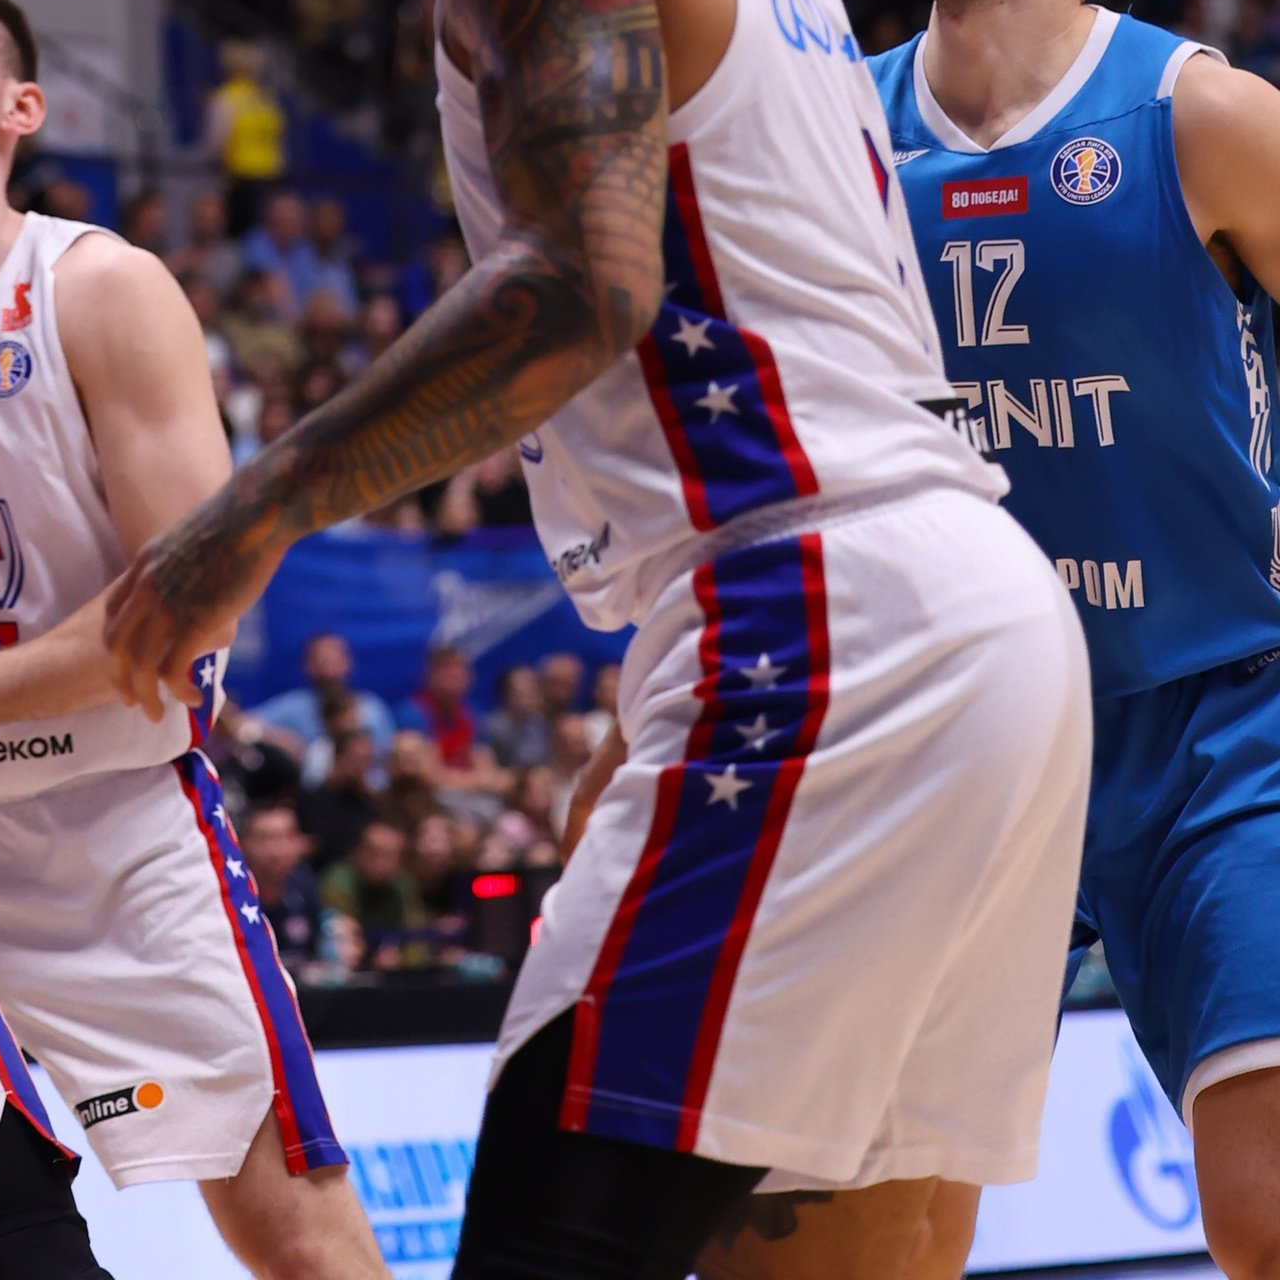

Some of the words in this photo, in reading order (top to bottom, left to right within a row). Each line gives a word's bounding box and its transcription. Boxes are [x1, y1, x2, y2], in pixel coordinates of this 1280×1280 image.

[1059, 141, 1086, 160] ЕДИНАЯ
[1086, 141, 1105, 151] ЛИГА
[951, 191, 970, 209] 80
[970, 188, 1019, 206] ПОБЕДА!
[1057, 182, 1068, 195] VTB
[1066, 192, 1091, 201] UNITED
[1090, 182, 1113, 200] LEAGUE
[939, 239, 1031, 347] 12
